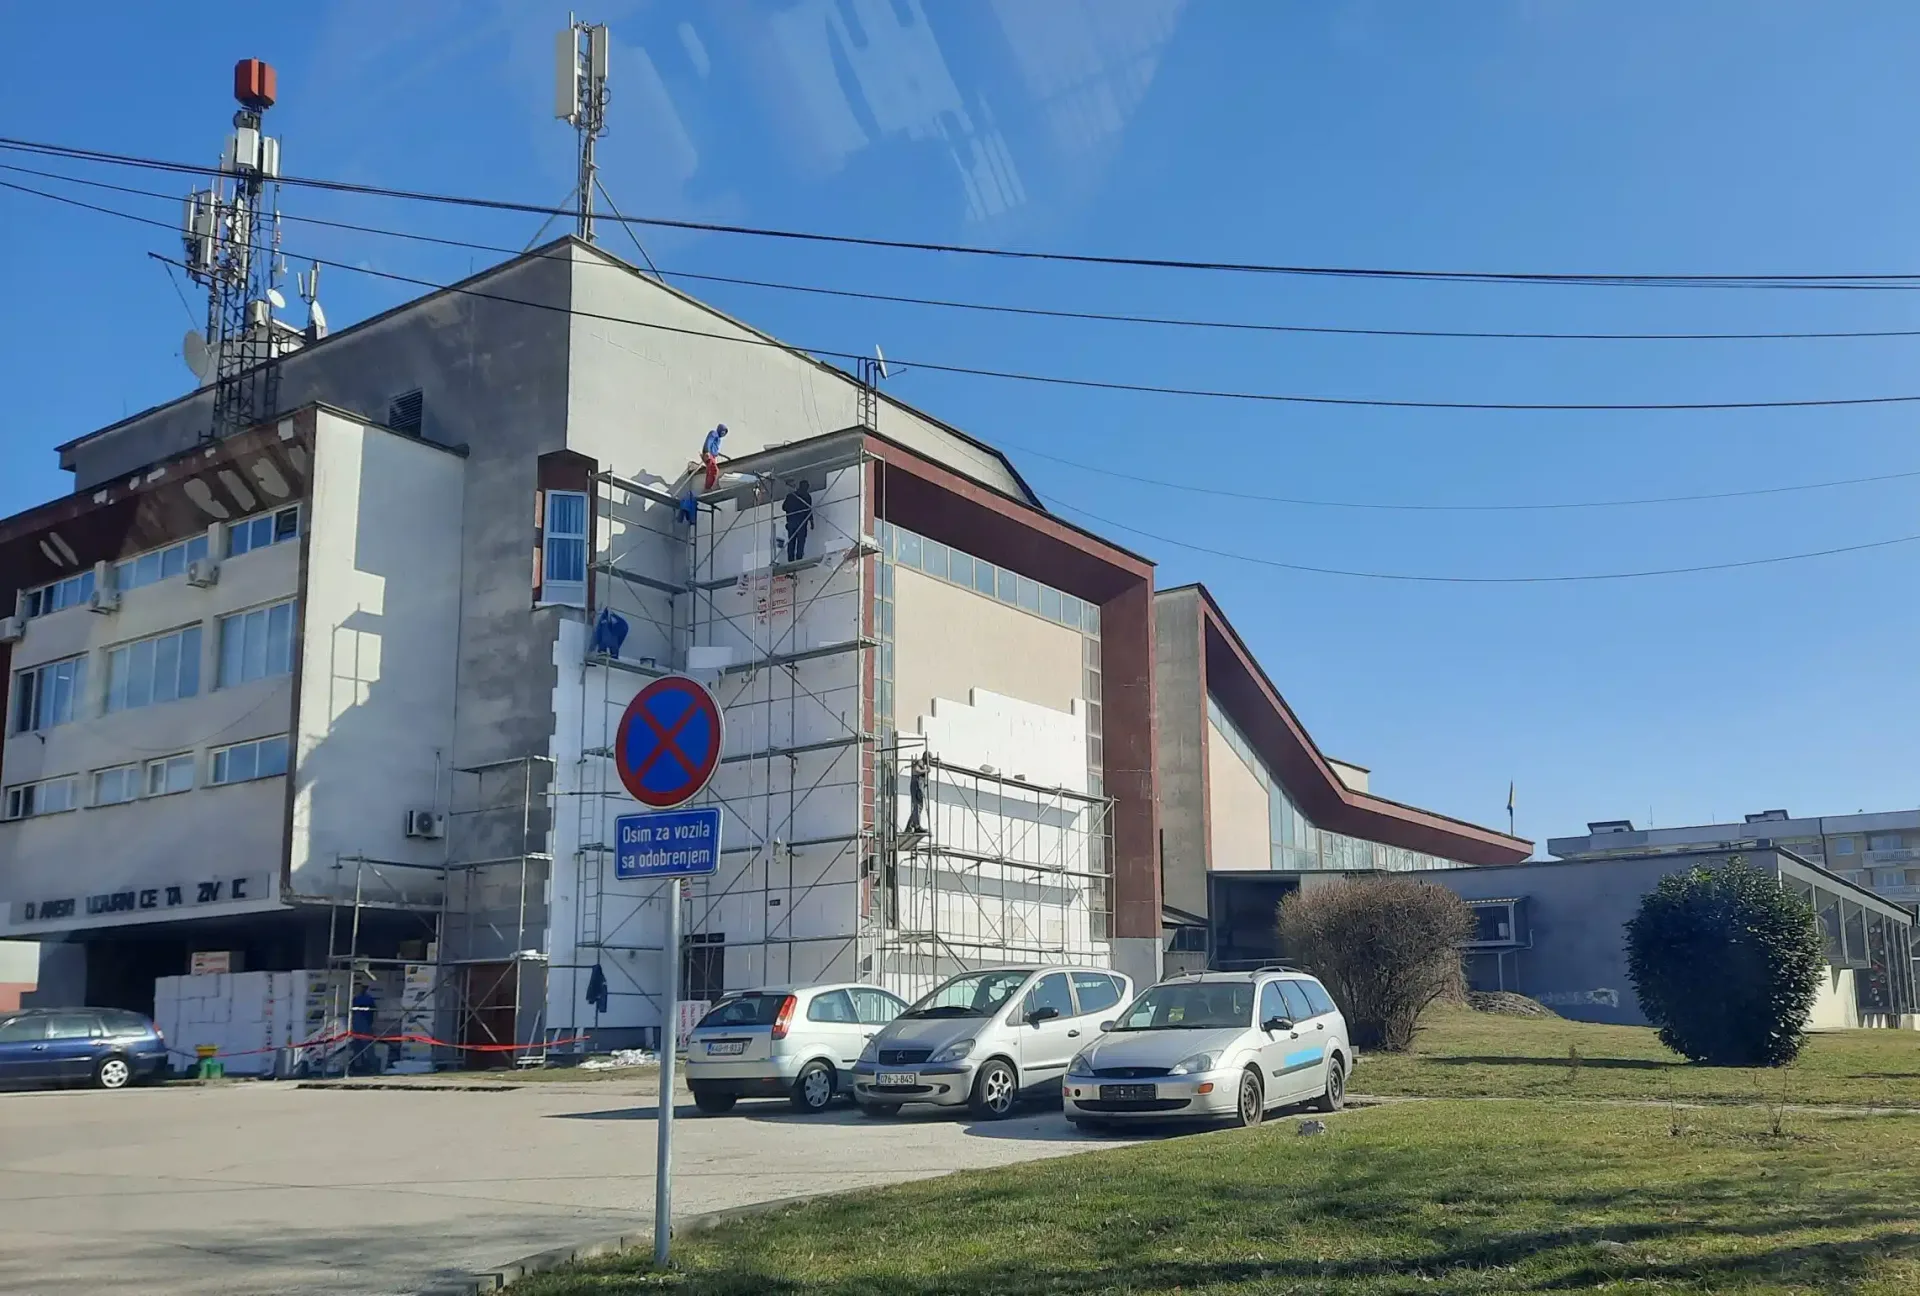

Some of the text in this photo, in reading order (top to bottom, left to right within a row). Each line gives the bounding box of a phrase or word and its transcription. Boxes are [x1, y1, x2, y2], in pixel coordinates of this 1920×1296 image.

[623, 820, 710, 843] Osim za vozila
[622, 847, 710, 869] sa odobrenjem
